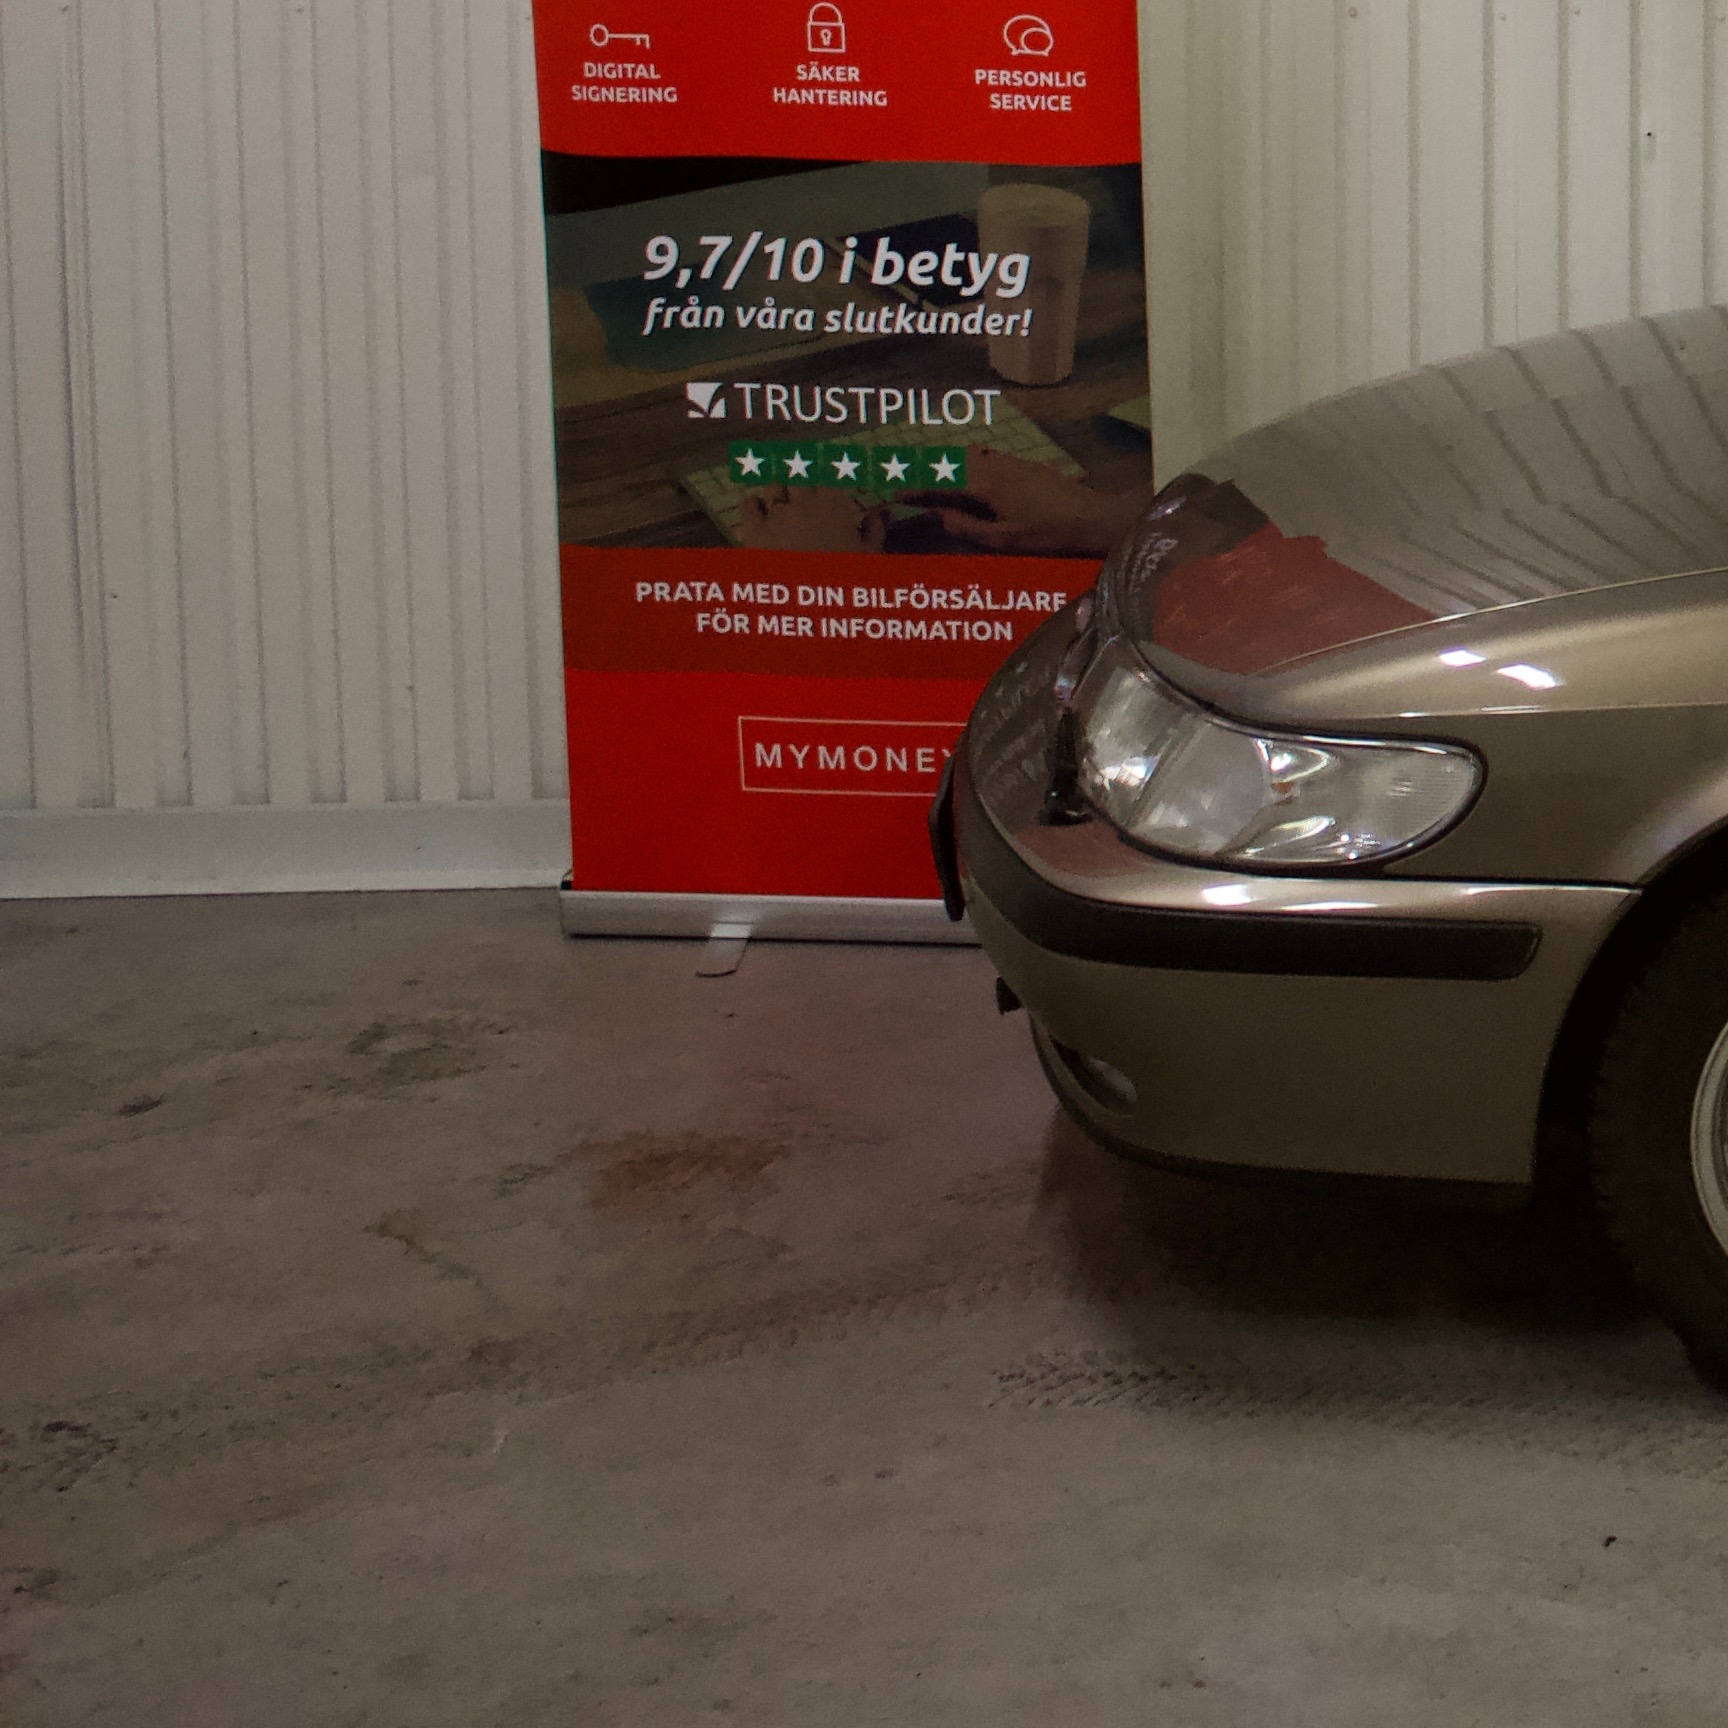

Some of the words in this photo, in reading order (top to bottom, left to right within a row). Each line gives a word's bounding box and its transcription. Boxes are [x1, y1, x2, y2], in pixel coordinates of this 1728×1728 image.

[583, 61, 662, 80] DIGITAL
[796, 61, 860, 83] SÄKER
[974, 68, 1087, 88] PERSONLIG
[571, 84, 678, 103] SIGNERING
[773, 86, 888, 107] HANTERING
[989, 92, 1072, 112] SERVICE
[643, 230, 824, 291] 9,7/10
[838, 238, 858, 284] i
[870, 236, 1030, 299] betyg
[642, 295, 725, 336] från
[736, 296, 815, 332] våra
[823, 301, 1033, 337] slutkunder!
[733, 382, 1002, 426] TRUSTPILOT
[635, 581, 725, 603] PRATA
[732, 581, 790, 605] MED
[797, 585, 845, 607] DIN
[695, 607, 750, 635] FÖR
[757, 614, 814, 638] MER
[820, 617, 1013, 642] INFORMATION
[754, 742, 951, 773] MYMONE
